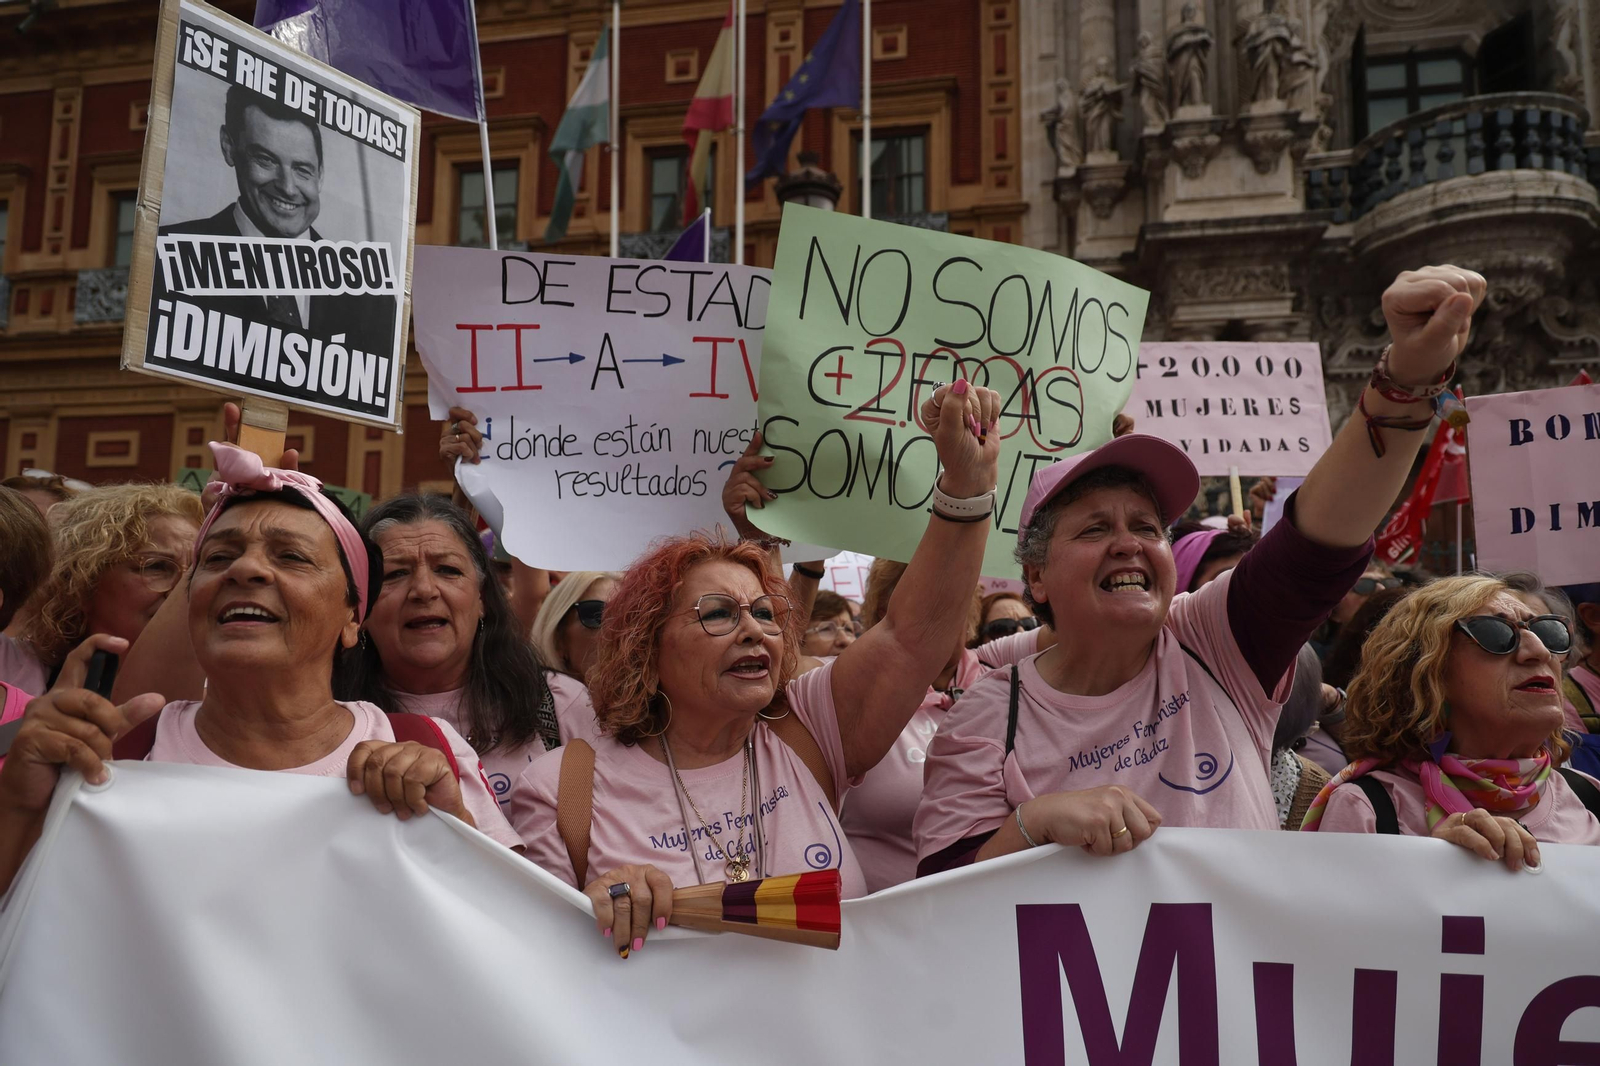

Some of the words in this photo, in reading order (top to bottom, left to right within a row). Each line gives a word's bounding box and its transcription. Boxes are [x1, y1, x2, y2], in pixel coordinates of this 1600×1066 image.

[183, 26, 228, 77] ¡SE
[235, 48, 277, 99] RIE
[284, 72, 317, 118] DE
[164, 240, 393, 291] ¡MENTIROSO!
[502, 255, 576, 308] DE
[799, 236, 912, 338] NO
[932, 256, 1132, 383] SOMOS
[153, 299, 389, 407] ¡DIMISIÓN!
[590, 332, 625, 391] A
[1146, 397, 1302, 417] MUJERES
[594, 414, 671, 454] están
[555, 463, 707, 500] resultados
[763, 415, 942, 510] SOMO
[1068, 735, 1130, 772] Mujeres
[1114, 755, 1132, 772] de
[1134, 738, 1169, 766] Cádiz
[705, 845, 723, 861] de
